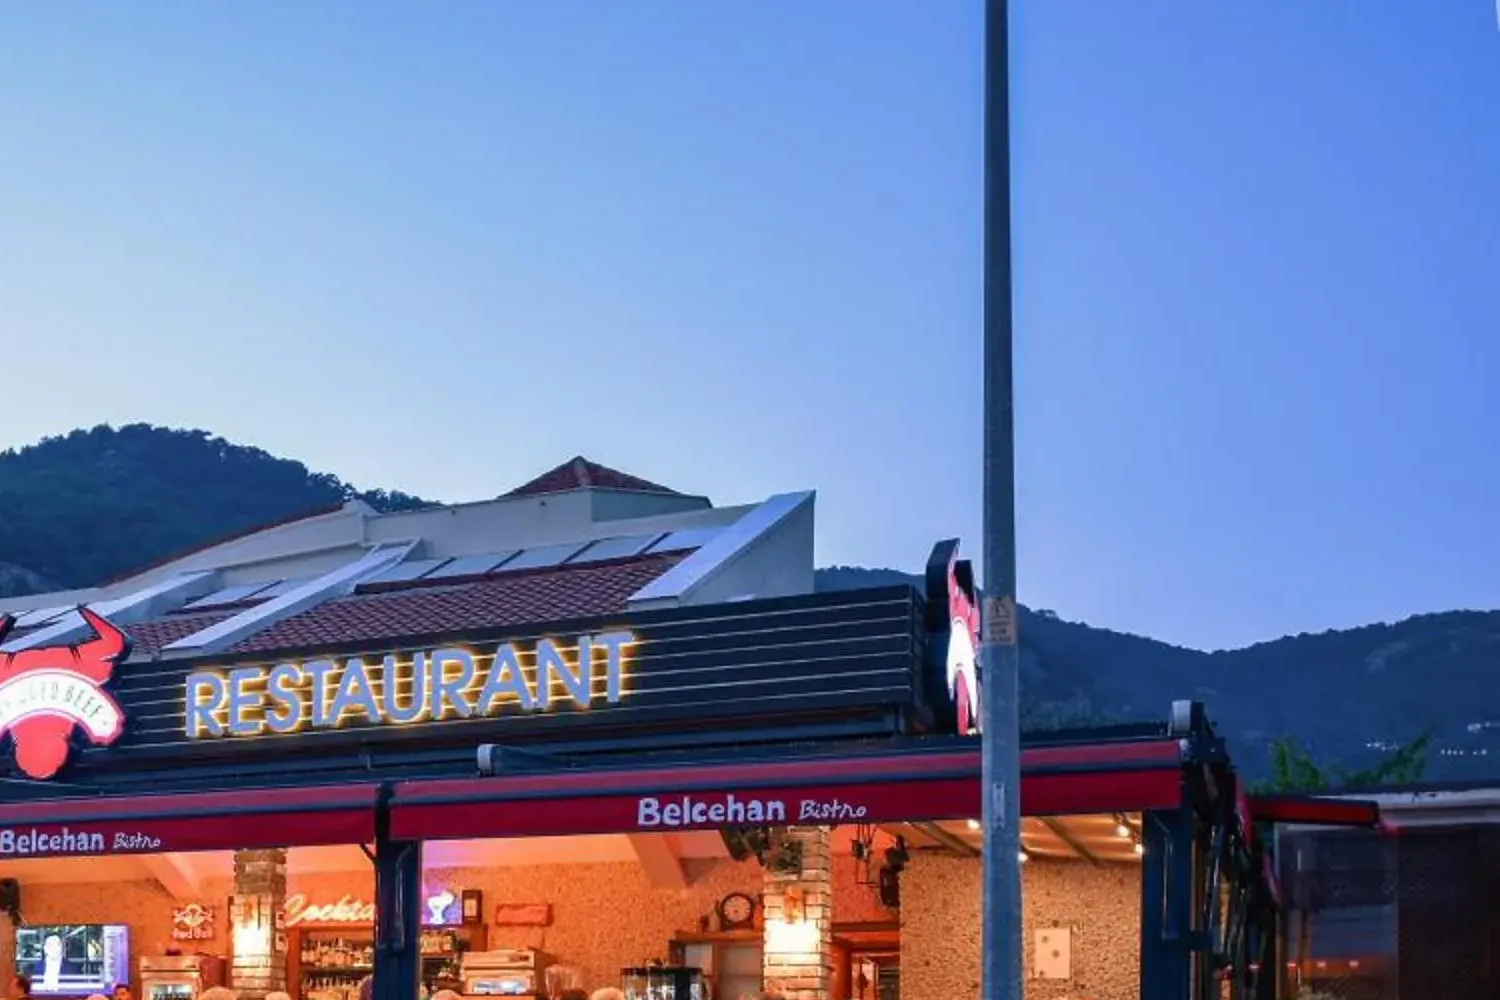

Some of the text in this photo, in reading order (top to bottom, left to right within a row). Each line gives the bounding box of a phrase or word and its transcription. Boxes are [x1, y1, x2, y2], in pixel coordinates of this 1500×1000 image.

[184, 630, 636, 738] RESTAURANT
[638, 795, 868, 826] Belcehan Bistro
[112, 832, 162, 849] Bistro
